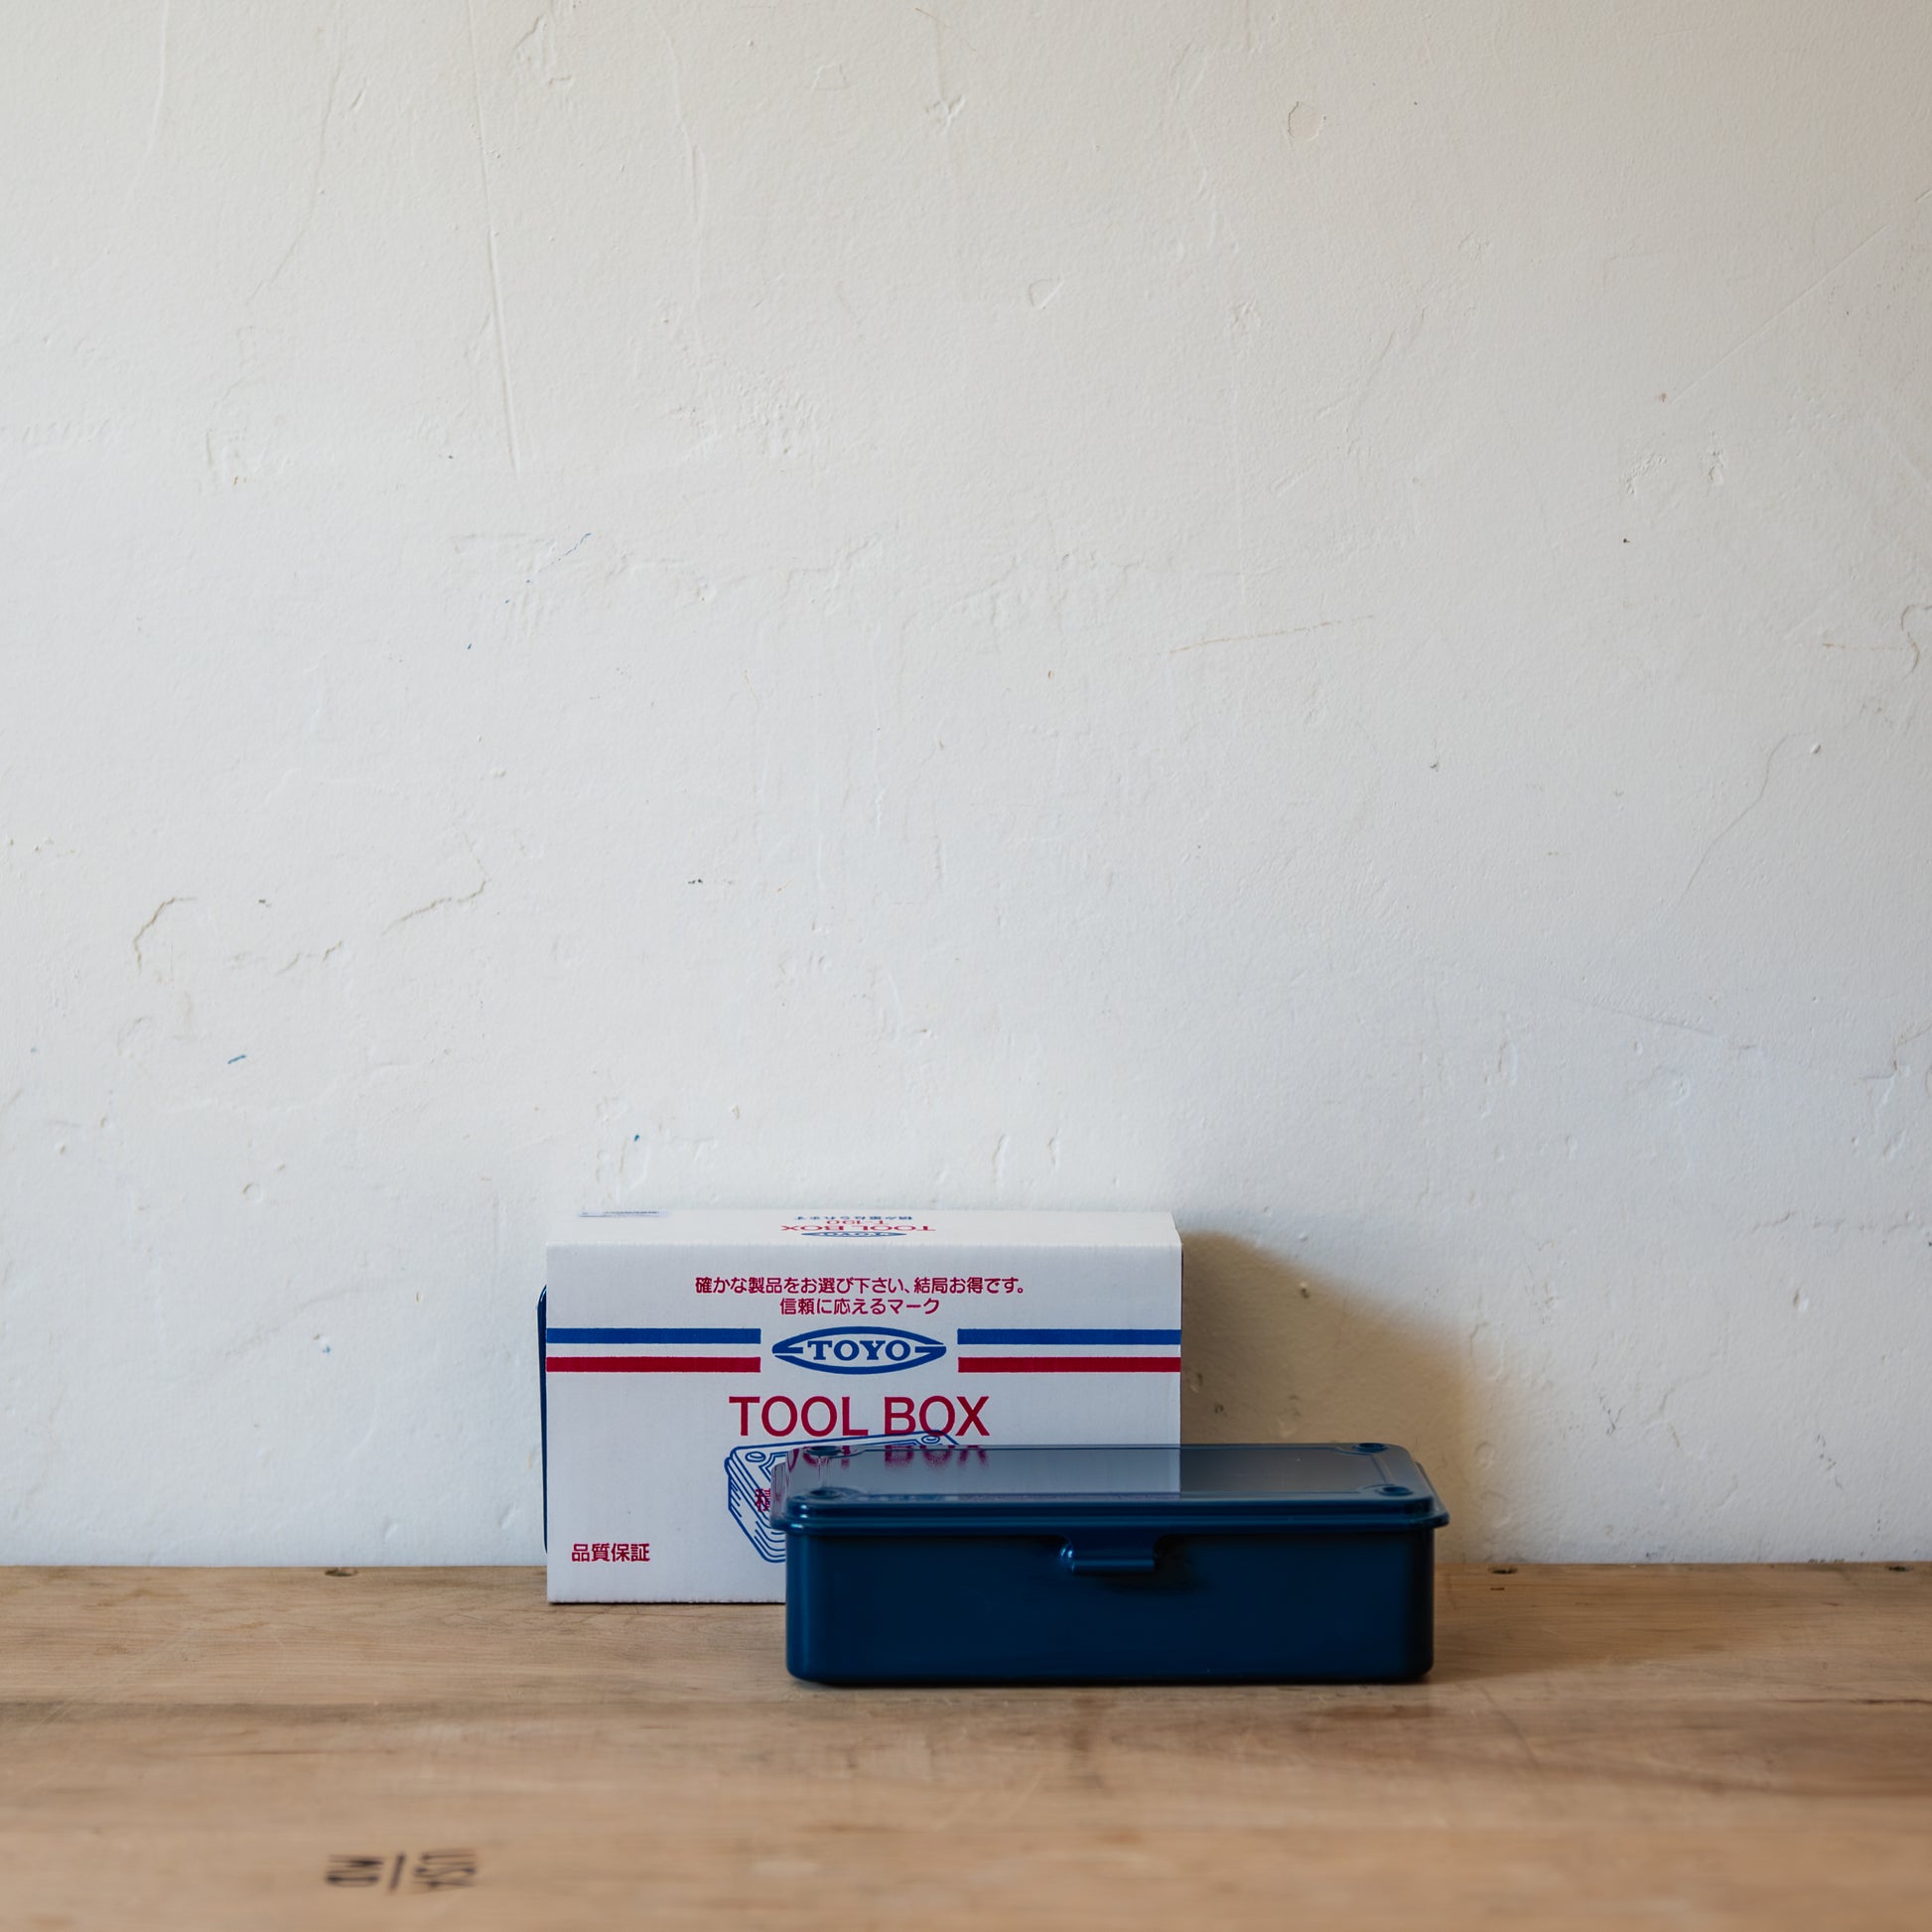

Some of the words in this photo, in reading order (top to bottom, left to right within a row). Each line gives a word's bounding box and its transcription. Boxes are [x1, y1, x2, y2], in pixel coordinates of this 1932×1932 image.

[695, 1277, 1024, 1294] 確かな製品をお選び下さい、結局お得です。
[780, 1298, 939, 1314] 信頼に応えるマーク
[807, 1339, 911, 1360] TOYO
[729, 1395, 869, 1437] TOOL
[884, 1395, 990, 1437] BOX
[571, 1543, 650, 1563] 品質保証
